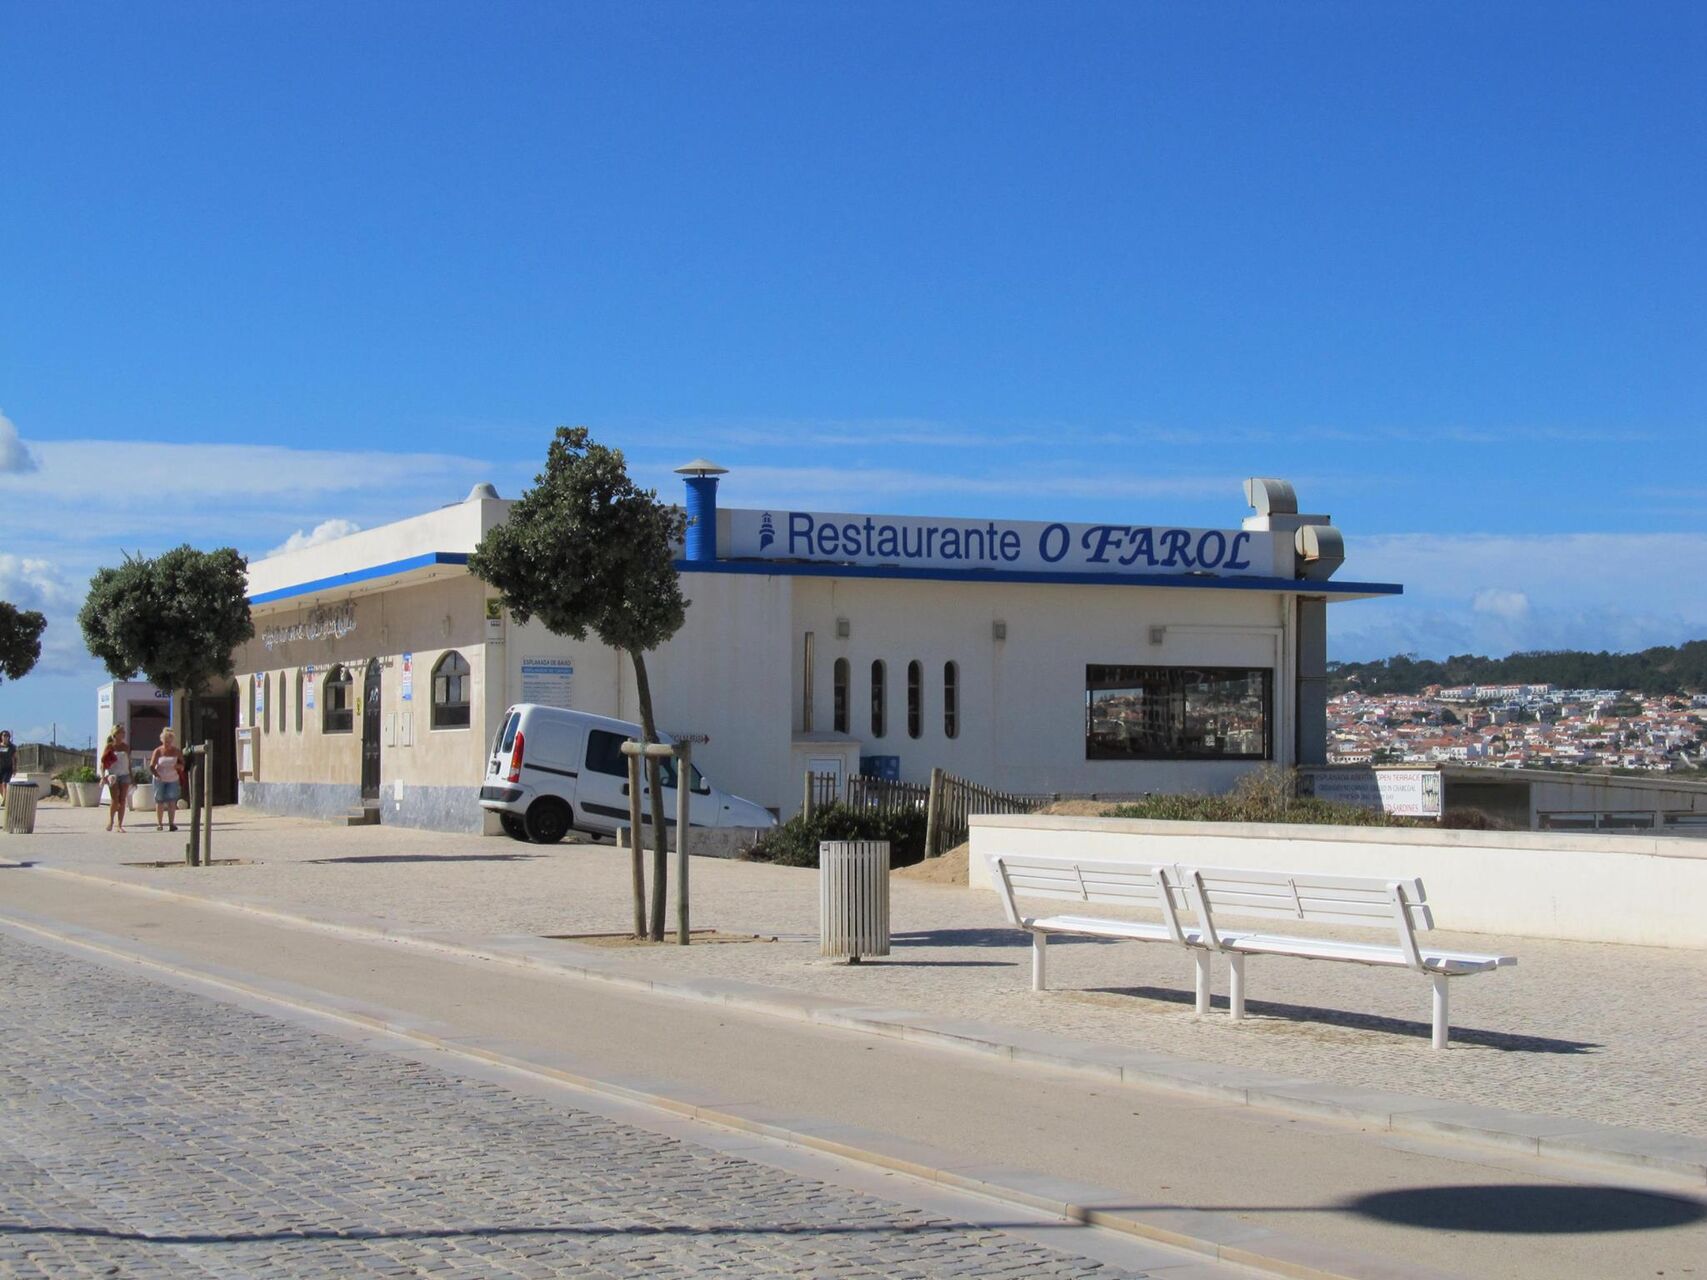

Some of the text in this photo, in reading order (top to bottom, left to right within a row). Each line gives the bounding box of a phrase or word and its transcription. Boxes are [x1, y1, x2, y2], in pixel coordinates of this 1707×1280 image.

[788, 511, 1251, 569] Restaurante O FAROL
[1393, 774, 1420, 782] TERRACE
